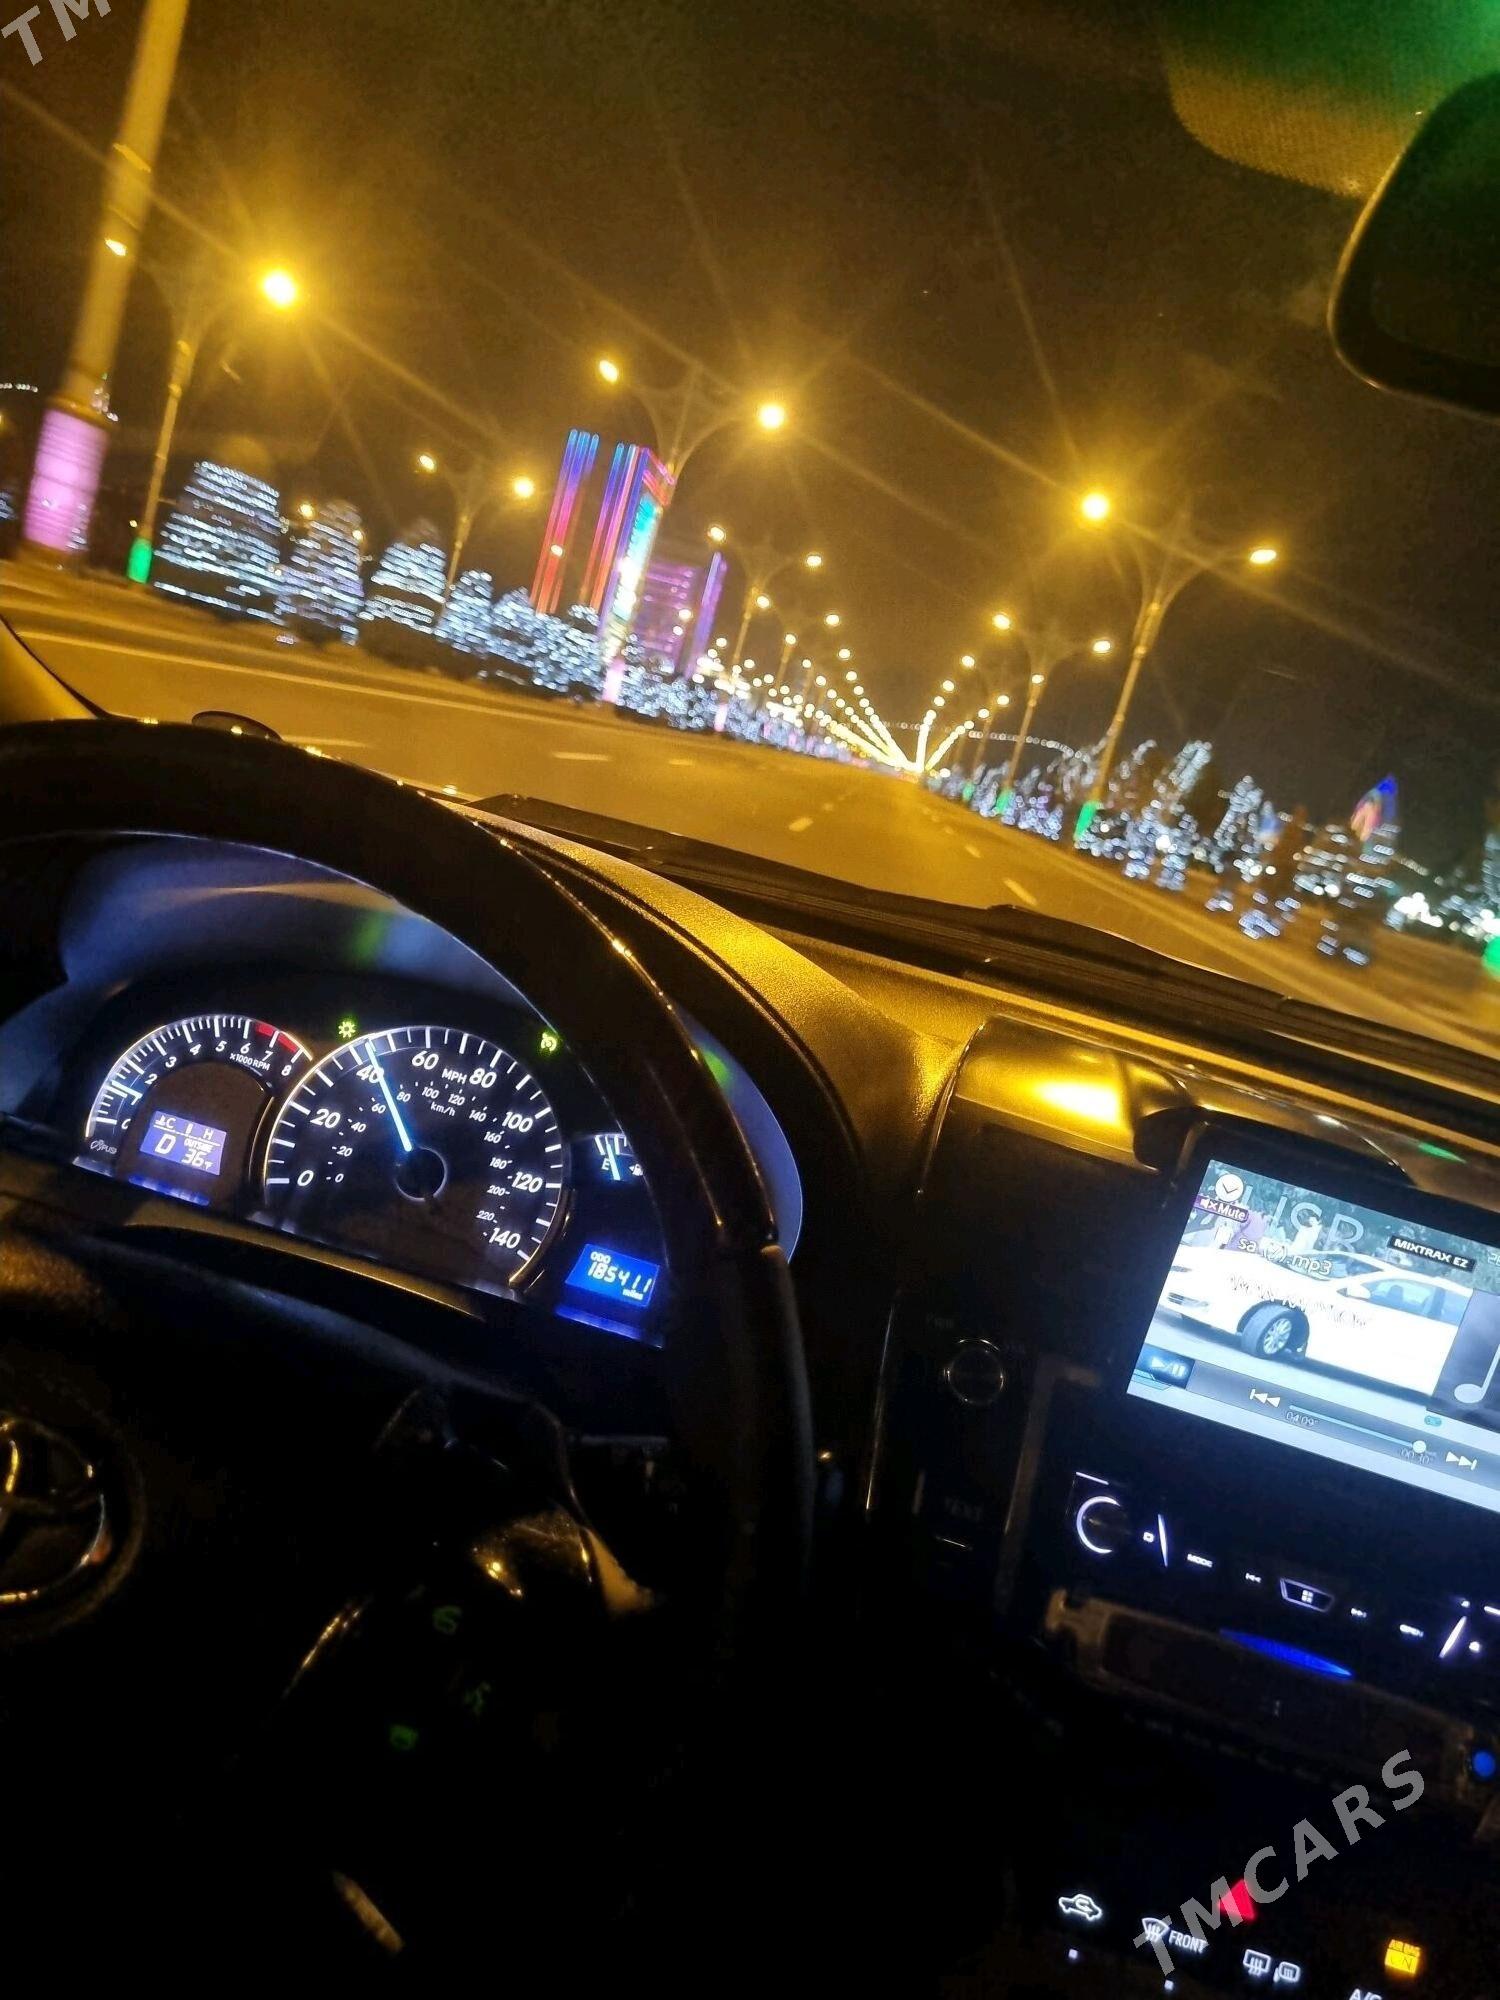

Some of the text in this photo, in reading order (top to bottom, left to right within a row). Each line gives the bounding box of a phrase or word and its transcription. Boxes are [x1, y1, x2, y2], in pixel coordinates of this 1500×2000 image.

[190, 1043, 202, 1056] 4
[216, 1040, 228, 1052] 5
[240, 1042, 251, 1054] 6
[165, 1056, 177, 1068] 3
[261, 1050, 274, 1062] 7
[411, 1050, 440, 1070] 60
[252, 1057, 271, 1072] RPM
[281, 1064, 293, 1077] 8
[144, 1073, 158, 1085] 2
[356, 1064, 385, 1084] 40
[442, 1068, 468, 1085] MPH
[469, 1067, 498, 1089] 80
[396, 1091, 412, 1103] 80
[421, 1086, 440, 1099] 100
[448, 1093, 466, 1106] 120
[371, 1103, 387, 1114] 60
[430, 1101, 457, 1117] km/h
[310, 1108, 341, 1128] 20
[468, 1109, 487, 1123] 140
[501, 1111, 534, 1133] 100
[166, 1118, 214, 1140] C H
[351, 1121, 367, 1133] 40
[483, 1131, 501, 1144] 160
[336, 1145, 353, 1157] 20
[489, 1157, 507, 1170] 180
[601, 1157, 610, 1171] E
[297, 1169, 315, 1187] 0
[334, 1173, 345, 1183] 0
[511, 1171, 543, 1193] 120
[487, 1185, 505, 1196] 200
[476, 1210, 495, 1222] 220
[1217, 1203, 1246, 1221] Mute
[488, 1227, 521, 1249] 140
[1238, 1237, 1257, 1253] sa
[590, 1251, 611, 1264] ODO
[1394, 1238, 1469, 1269] MIXTRAX EZ
[588, 1261, 653, 1293] 185411
[1187, 1553, 1213, 1568] MODE
[1169, 1930, 1207, 1954] FRONT
